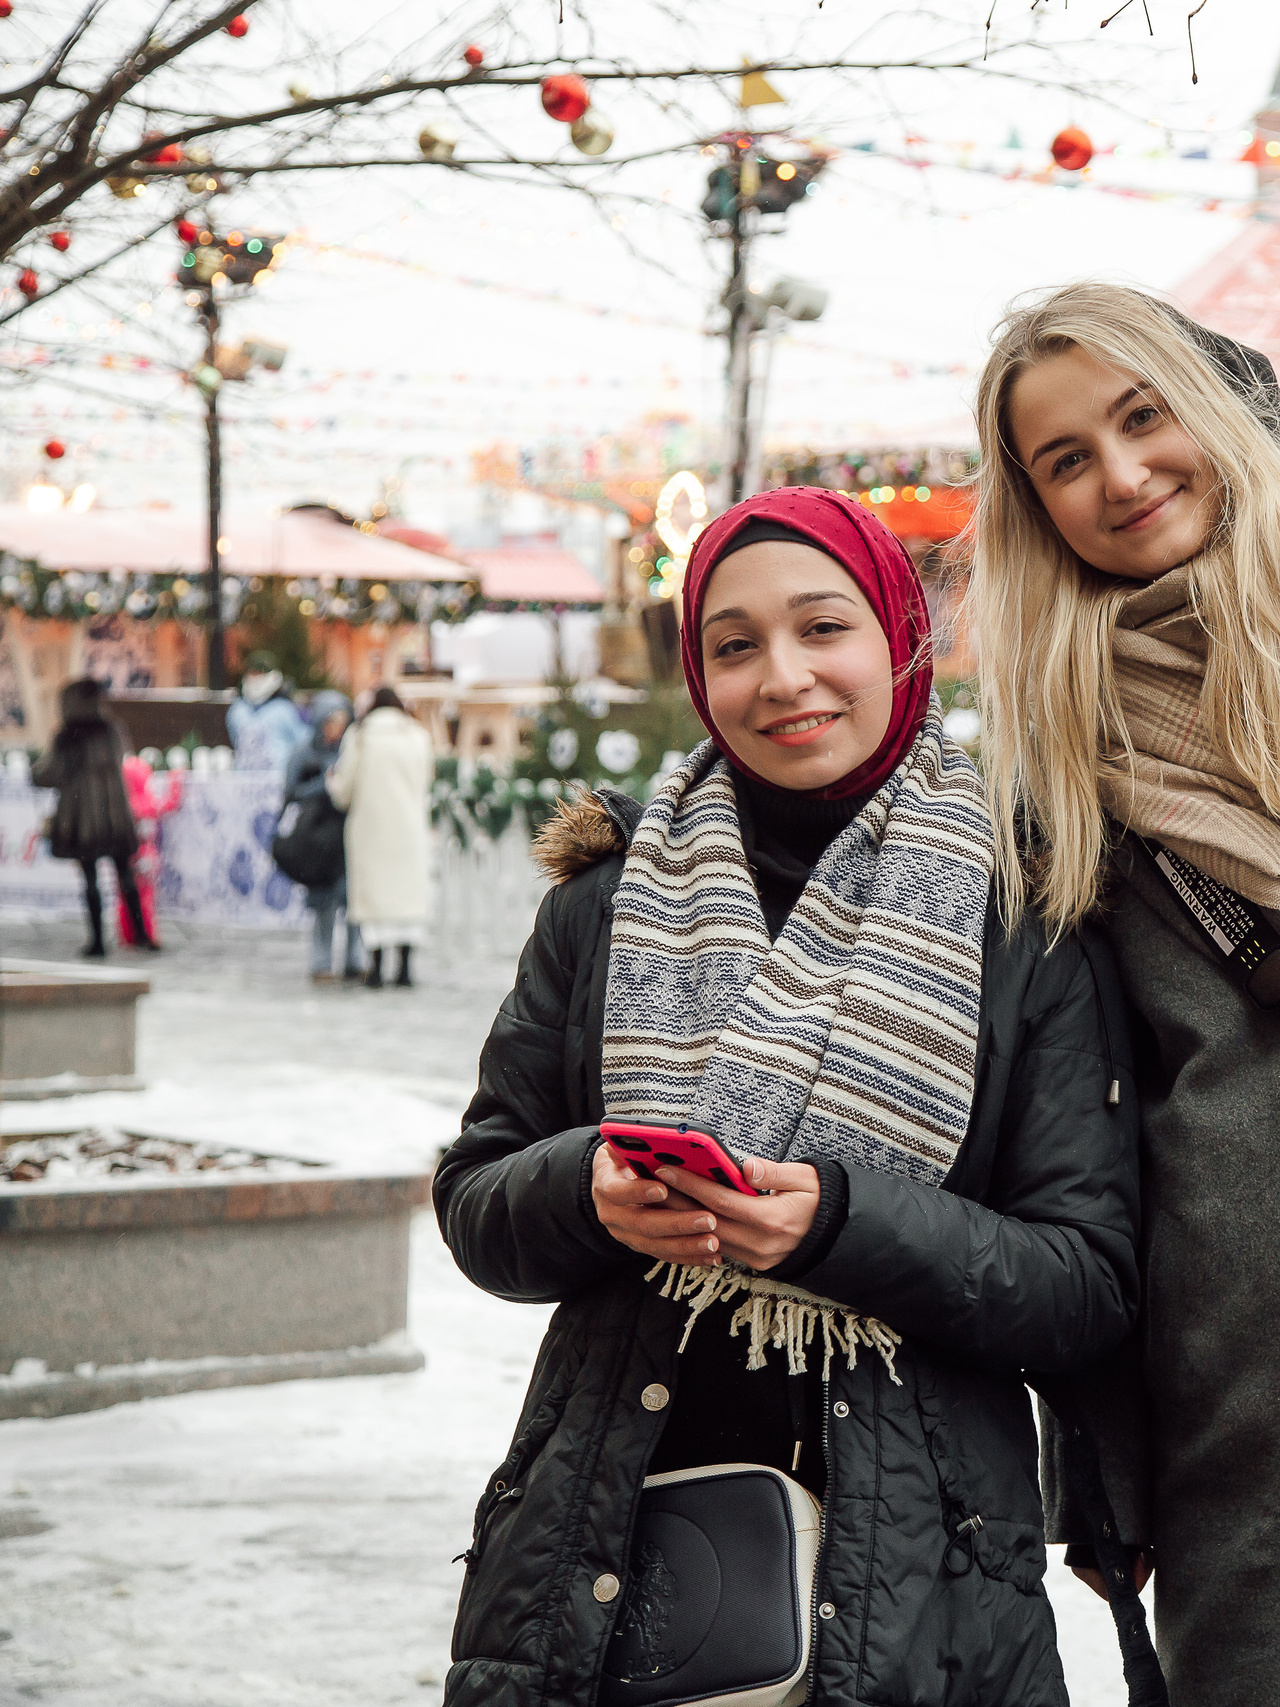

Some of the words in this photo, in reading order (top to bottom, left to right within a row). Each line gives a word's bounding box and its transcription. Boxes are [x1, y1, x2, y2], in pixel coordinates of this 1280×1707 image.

[1194, 888, 1208, 905] USE
[1197, 879, 1215, 902] WHEN
[1208, 882, 1238, 918] SNAPSHOT
[1225, 892, 1235, 901] AT
[1169, 871, 1217, 935] WARNING
[1211, 909, 1239, 944] PLEASE
[1216, 903, 1244, 938] CAUTION
[1235, 904, 1254, 927] WEAR
[1237, 918, 1248, 933] THE
